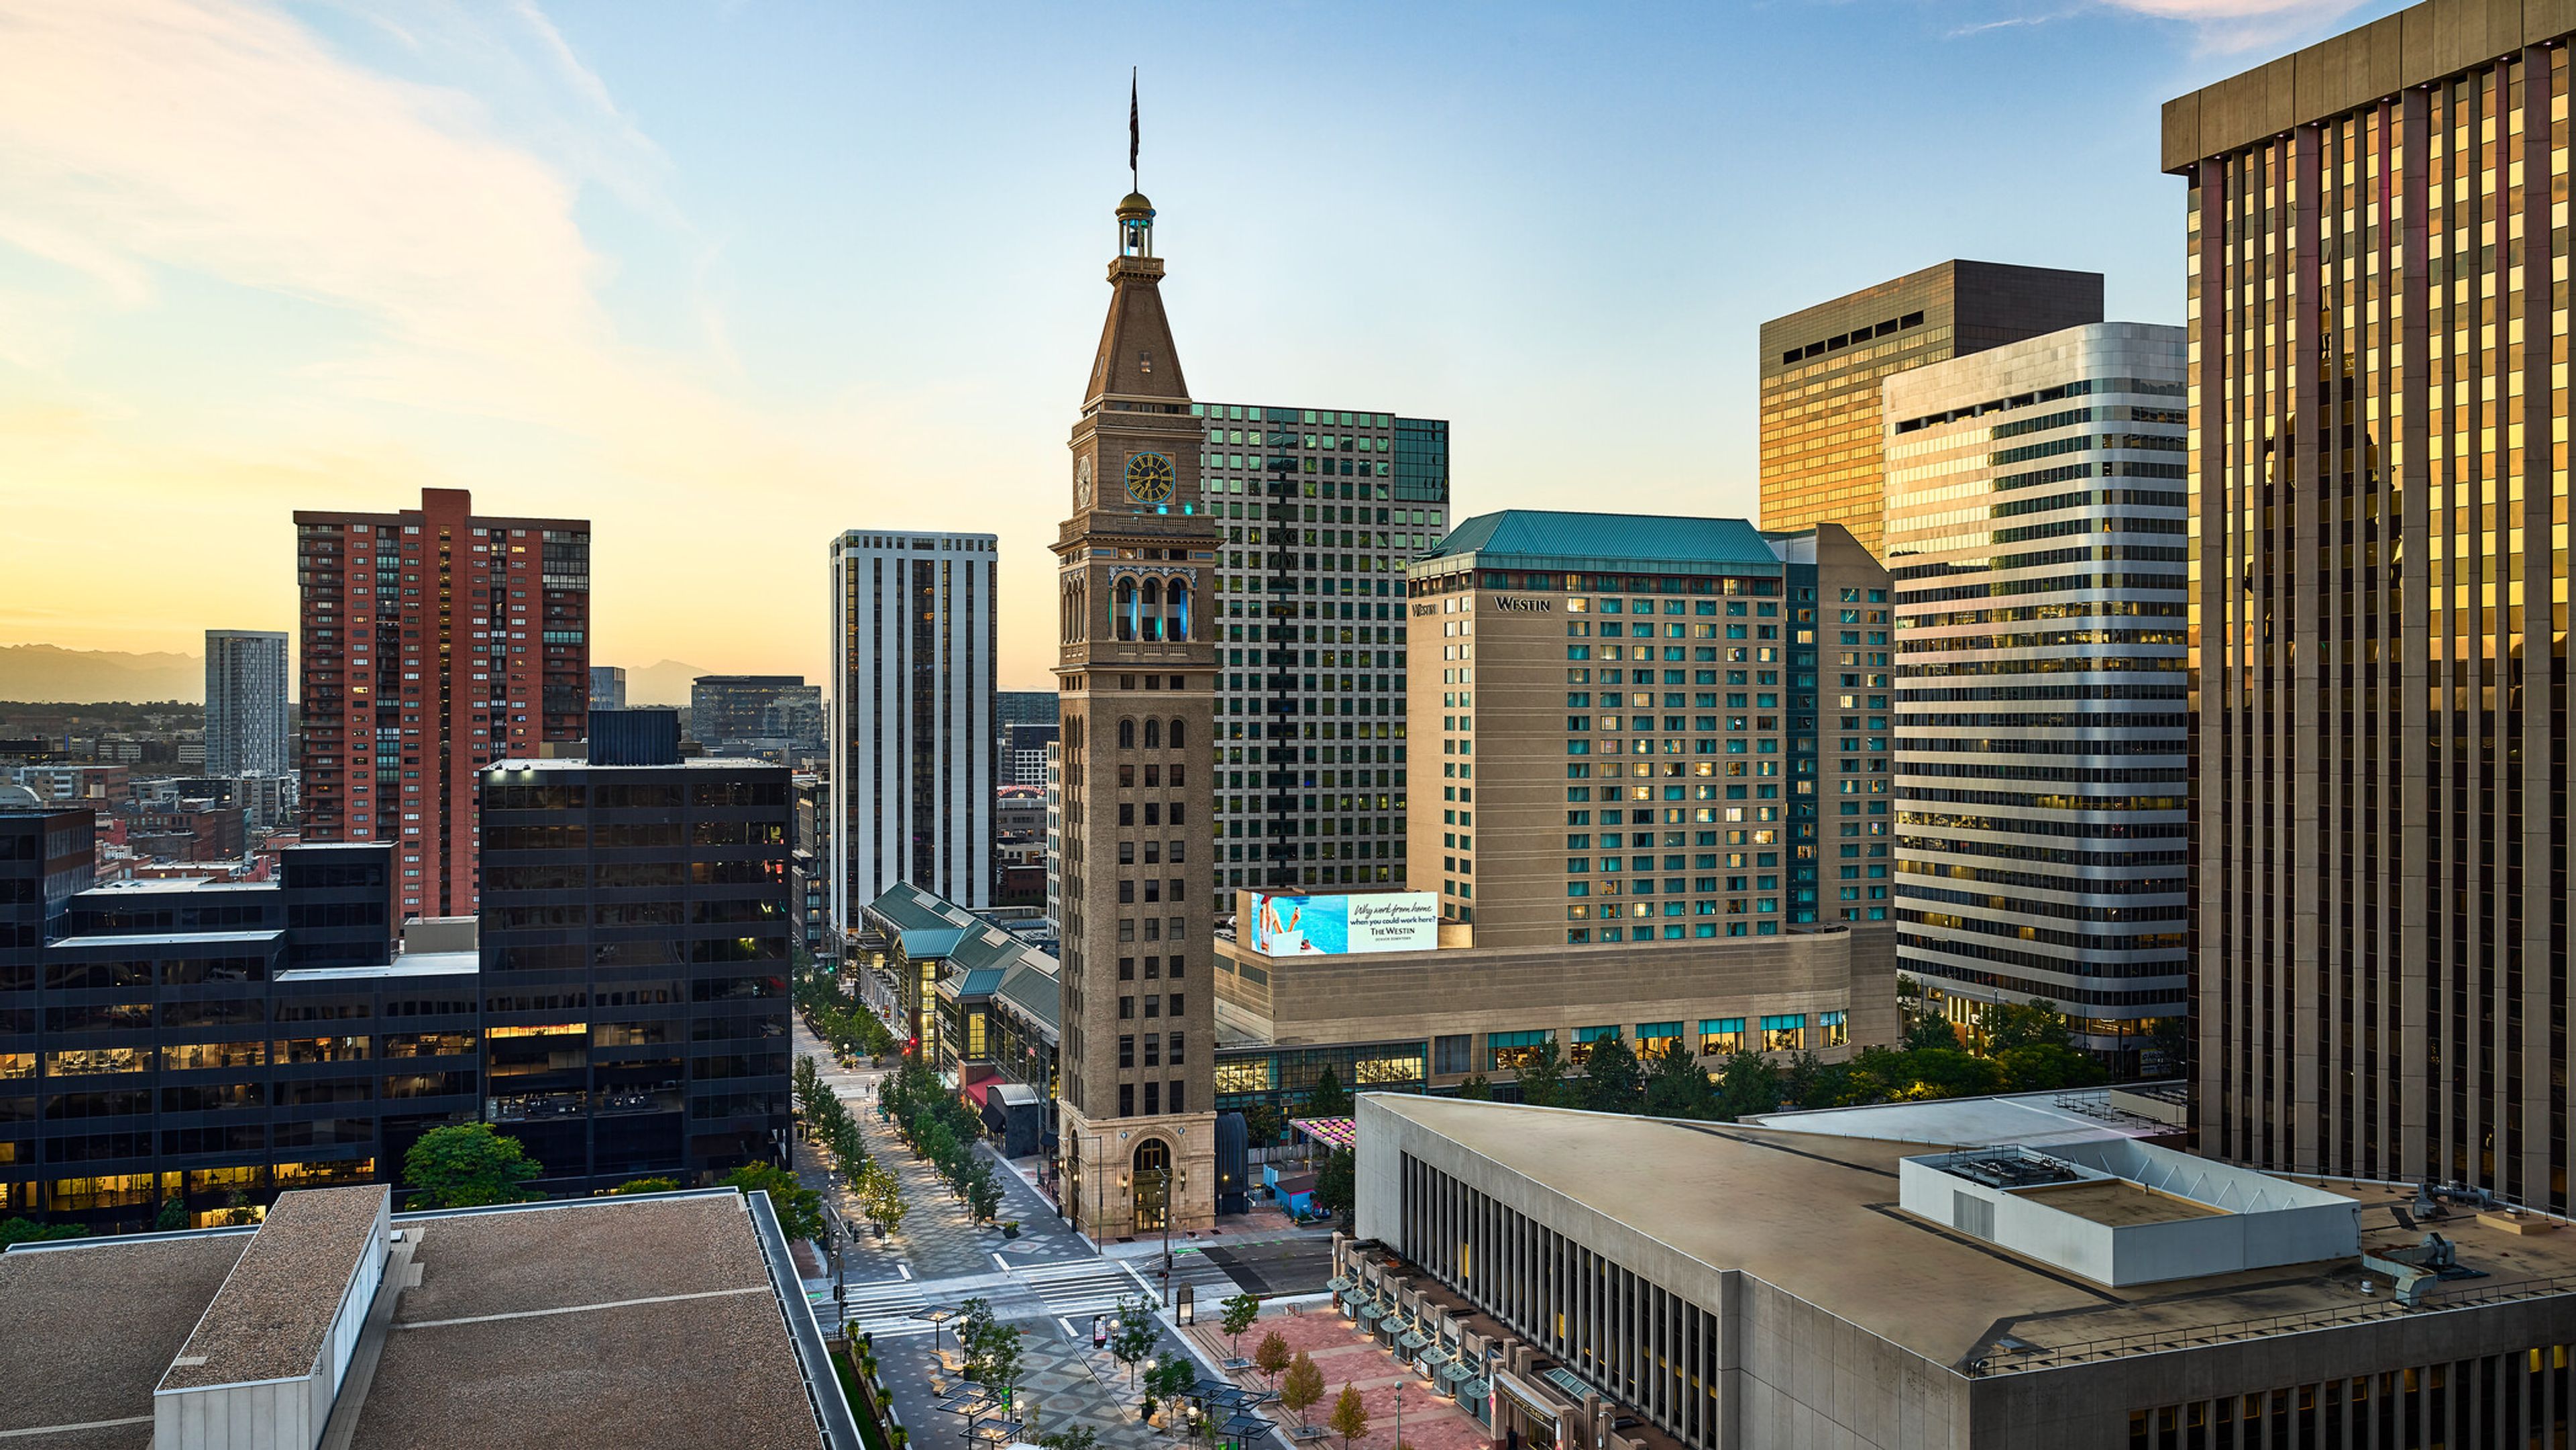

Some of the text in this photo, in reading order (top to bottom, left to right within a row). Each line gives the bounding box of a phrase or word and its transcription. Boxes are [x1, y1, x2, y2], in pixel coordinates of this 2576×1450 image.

[1494, 596, 1550, 612] WESTIN
[1354, 902, 1433, 919] Why work from home
[1371, 927, 1415, 935] THE WESTIN
